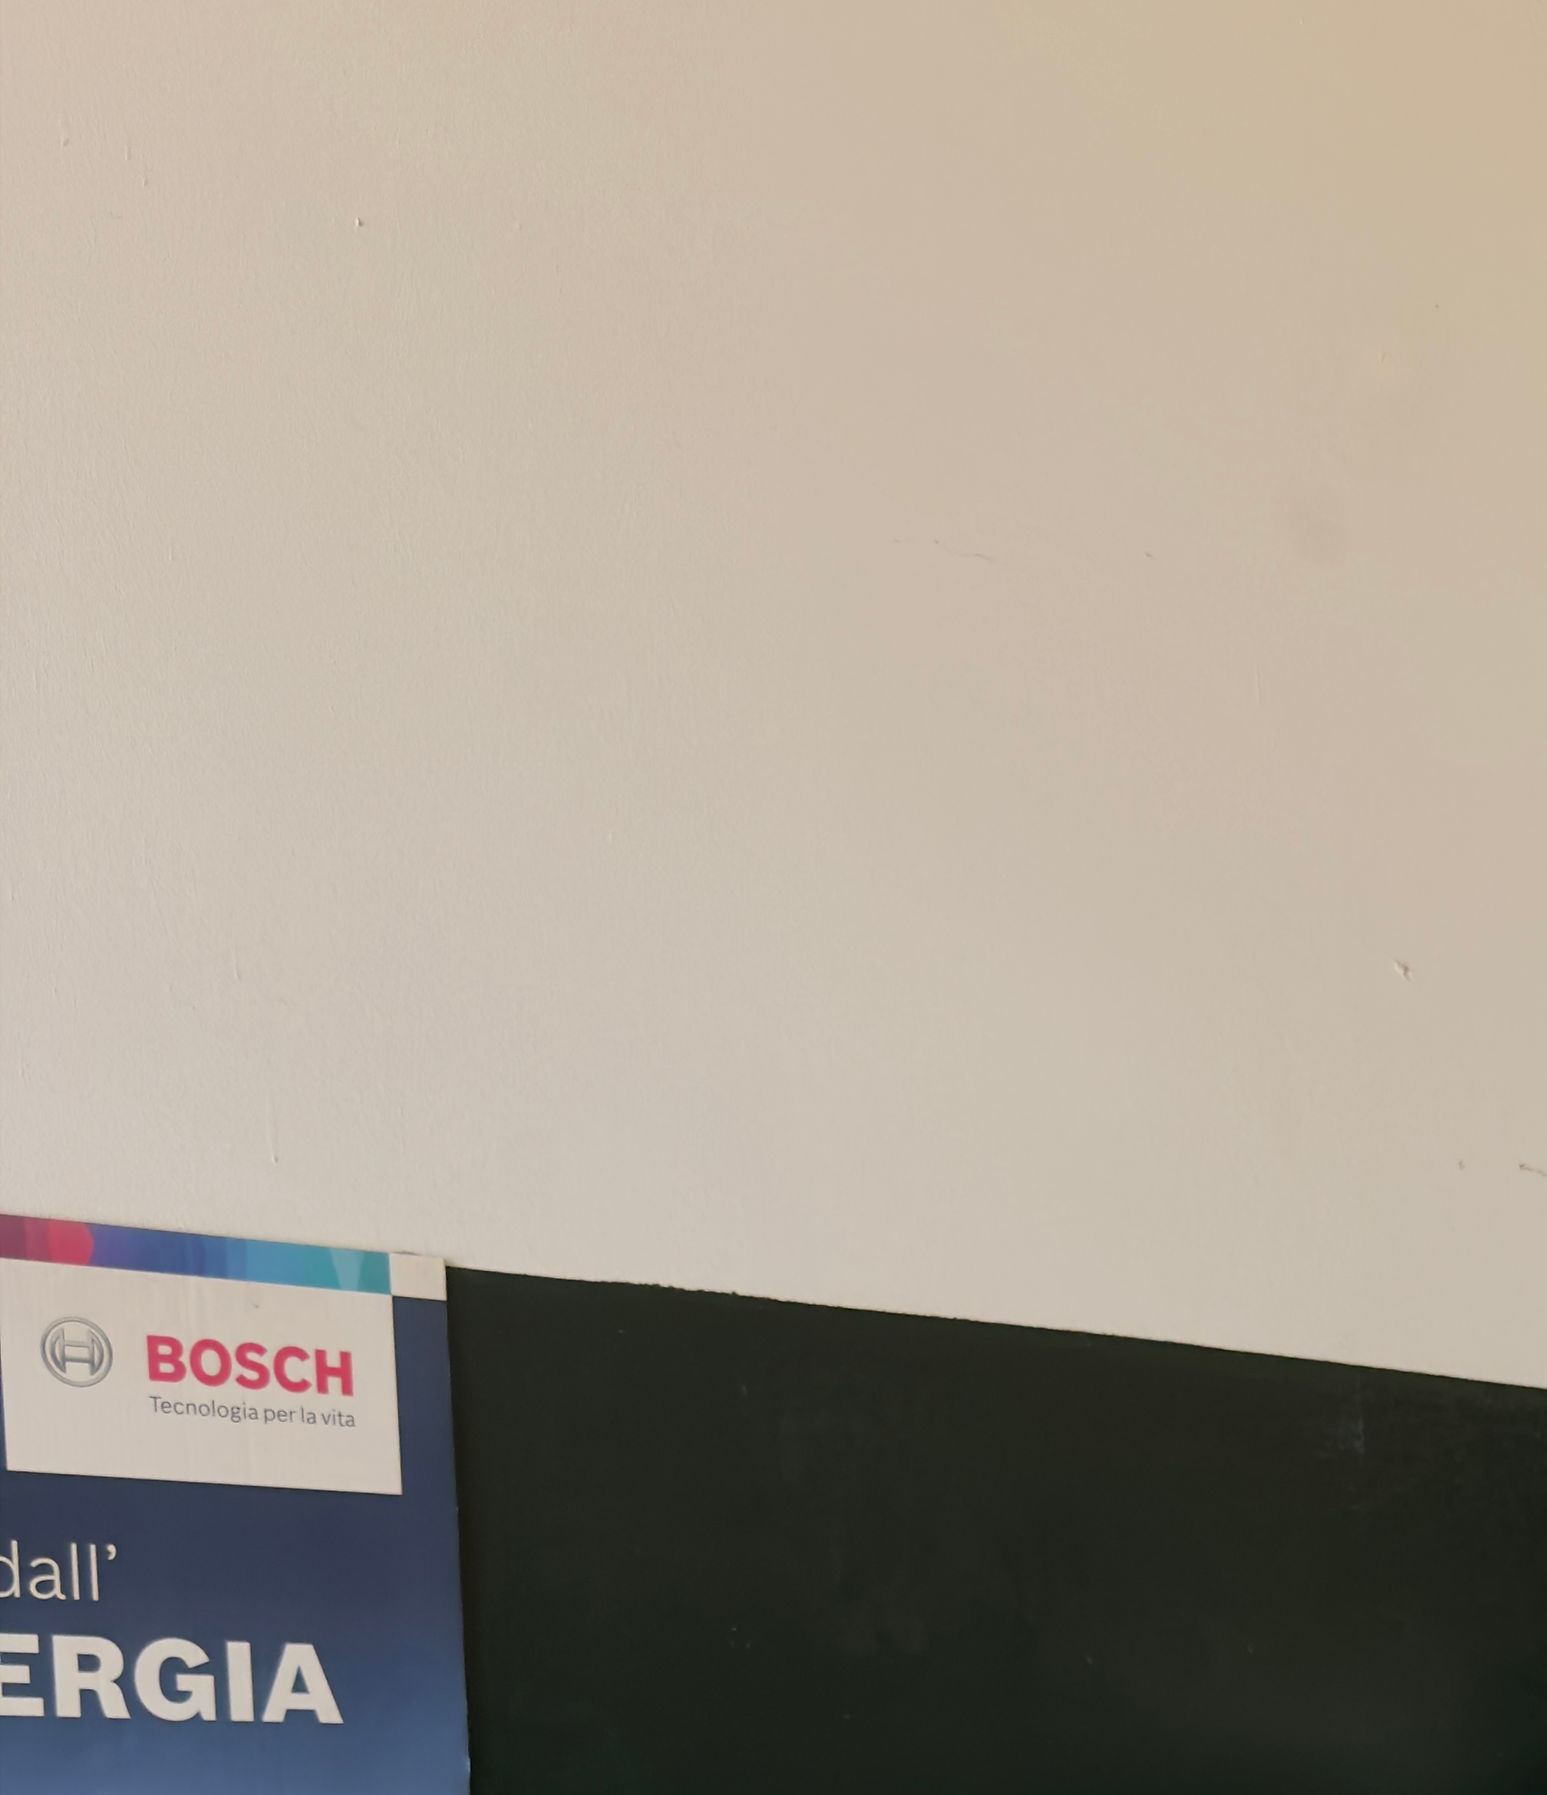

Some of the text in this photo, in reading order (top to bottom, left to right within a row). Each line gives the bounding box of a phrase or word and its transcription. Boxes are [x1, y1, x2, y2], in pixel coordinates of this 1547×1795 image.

[146, 1334, 354, 1397] BOSCH
[149, 1396, 356, 1428] Tecnologia per la vita
